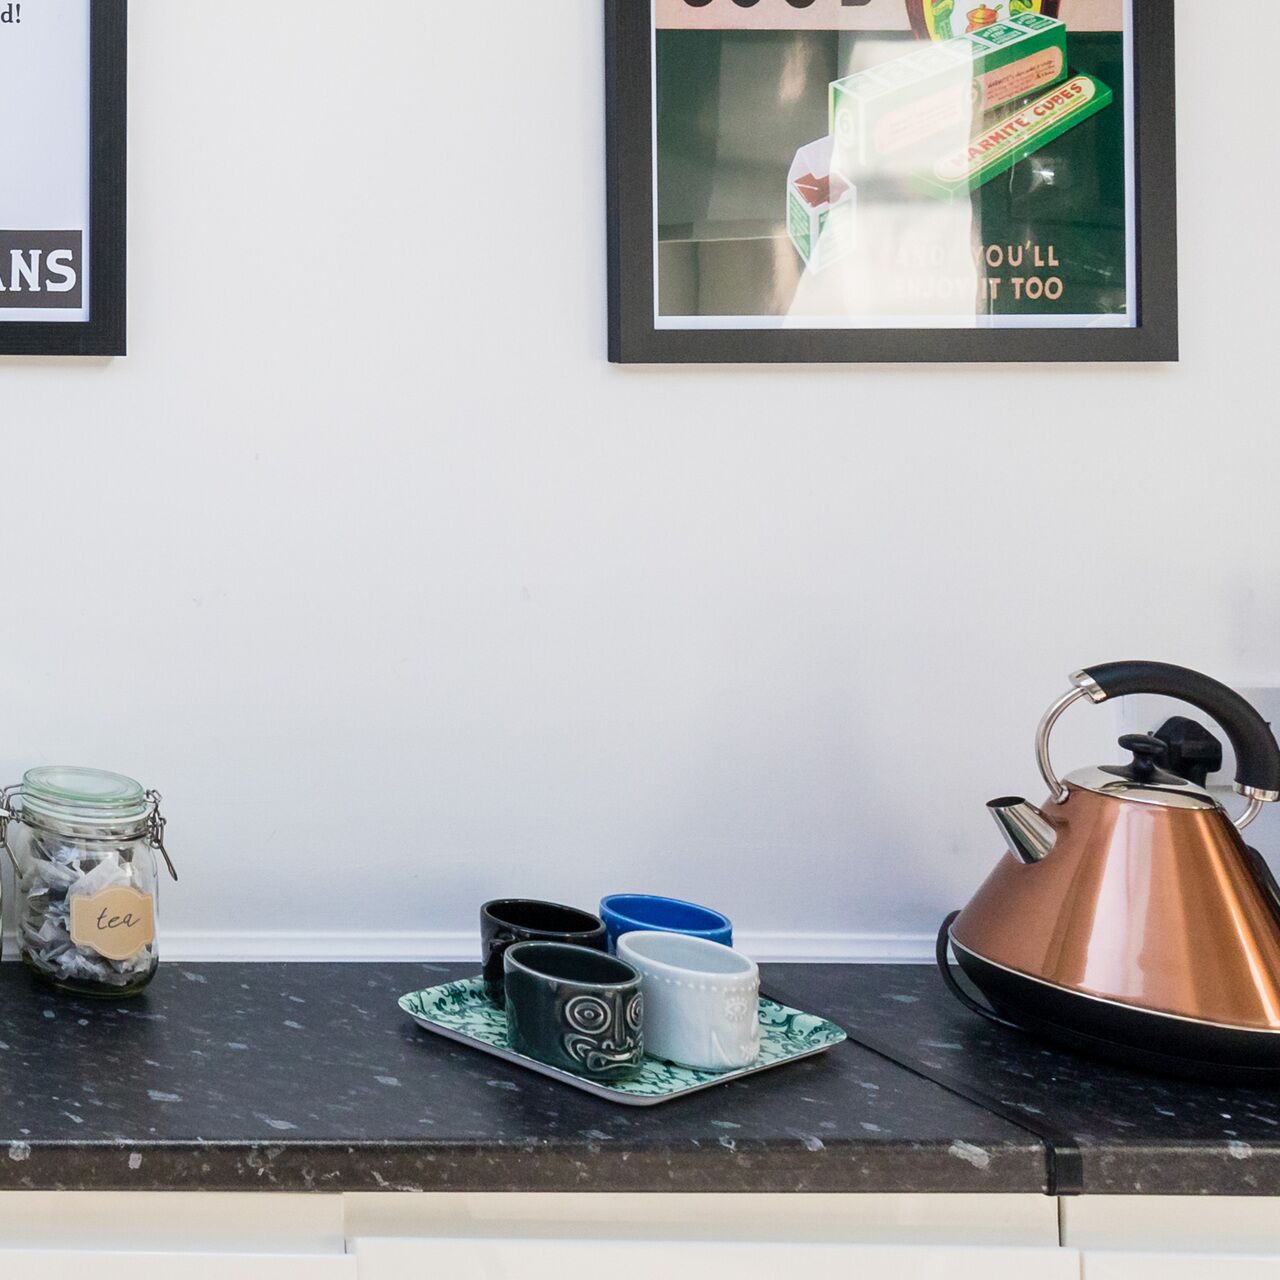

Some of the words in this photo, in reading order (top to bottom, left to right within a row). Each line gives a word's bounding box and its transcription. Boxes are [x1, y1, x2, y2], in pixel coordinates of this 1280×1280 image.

[1033, 83, 1083, 116] CUBES
[981, 277, 1001, 299] IT
[1011, 276, 1063, 300] TOO
